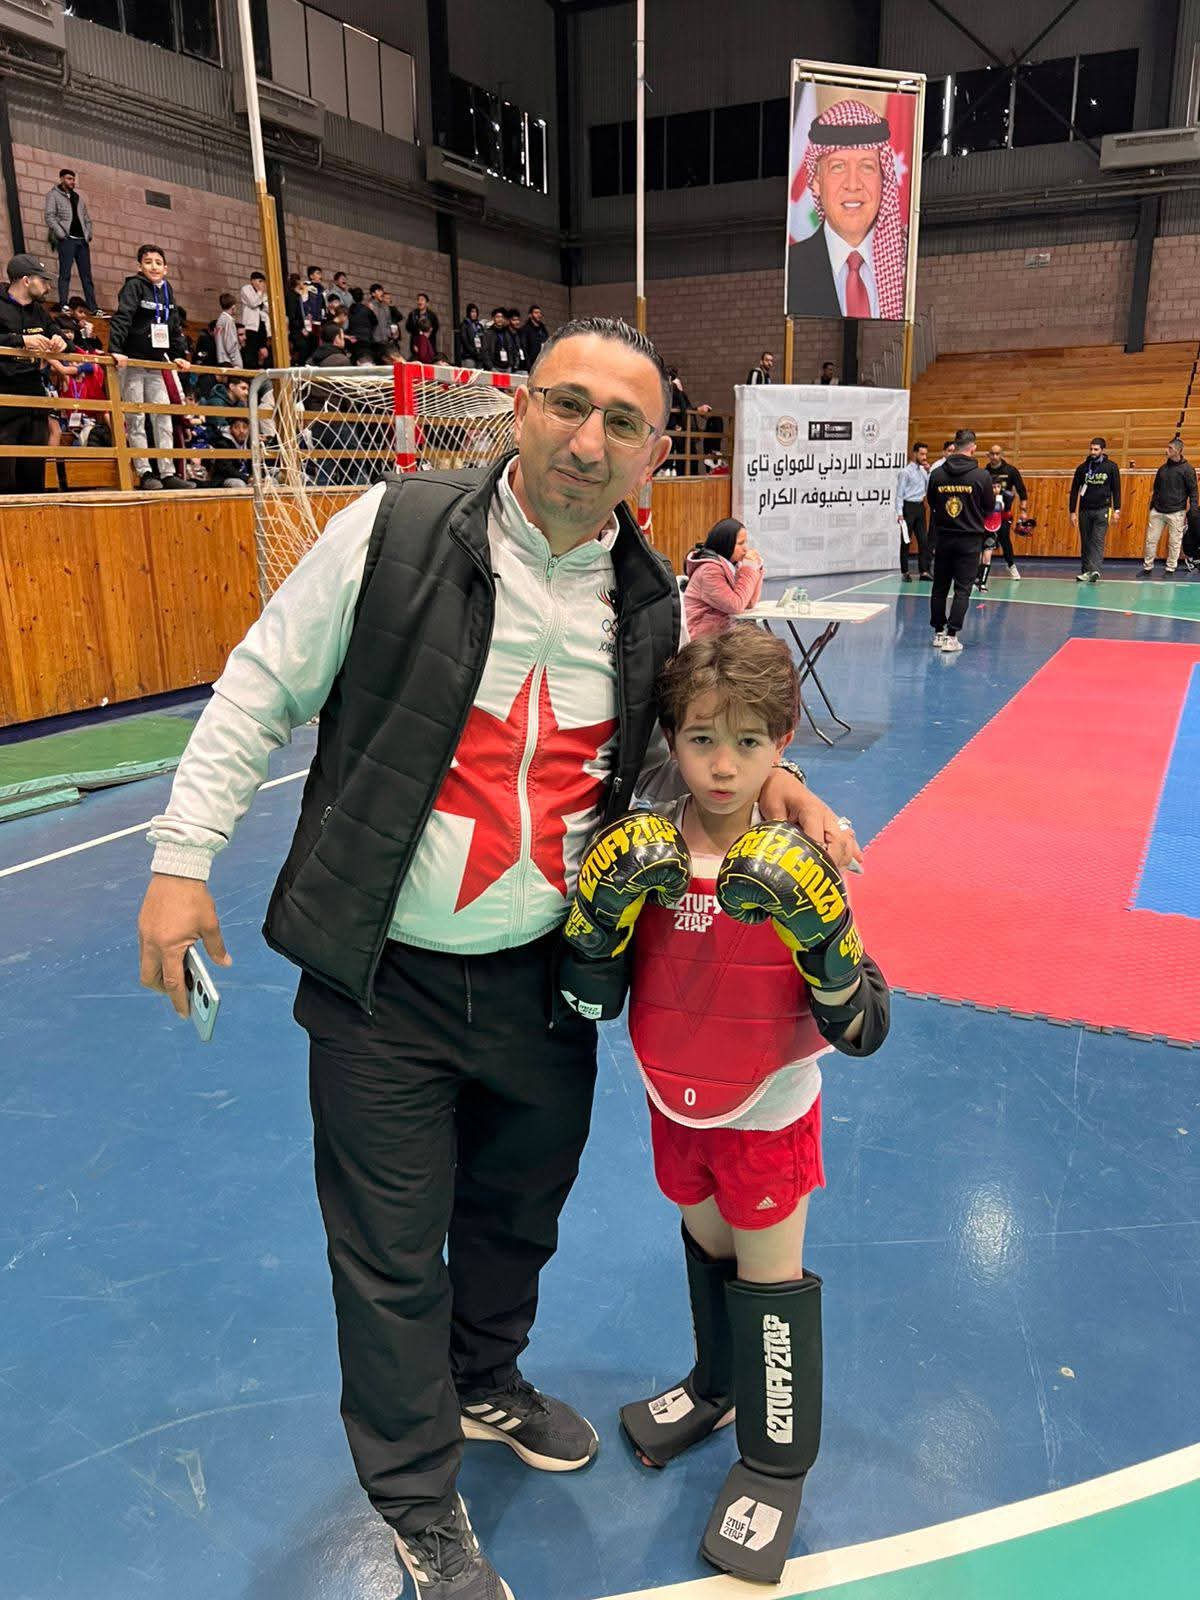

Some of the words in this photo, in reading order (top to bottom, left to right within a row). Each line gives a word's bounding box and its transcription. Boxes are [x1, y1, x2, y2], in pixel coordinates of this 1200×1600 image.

[747, 453, 770, 482] تاي
[773, 453, 815, 481] للمواي
[818, 453, 862, 481] الاردني
[866, 452, 905, 470] الاتحاد
[758, 487, 797, 515] الكرام
[801, 486, 852, 508] بضيوفه
[856, 488, 891, 507] يرحب
[725, 1516, 747, 1532] 2TUF
